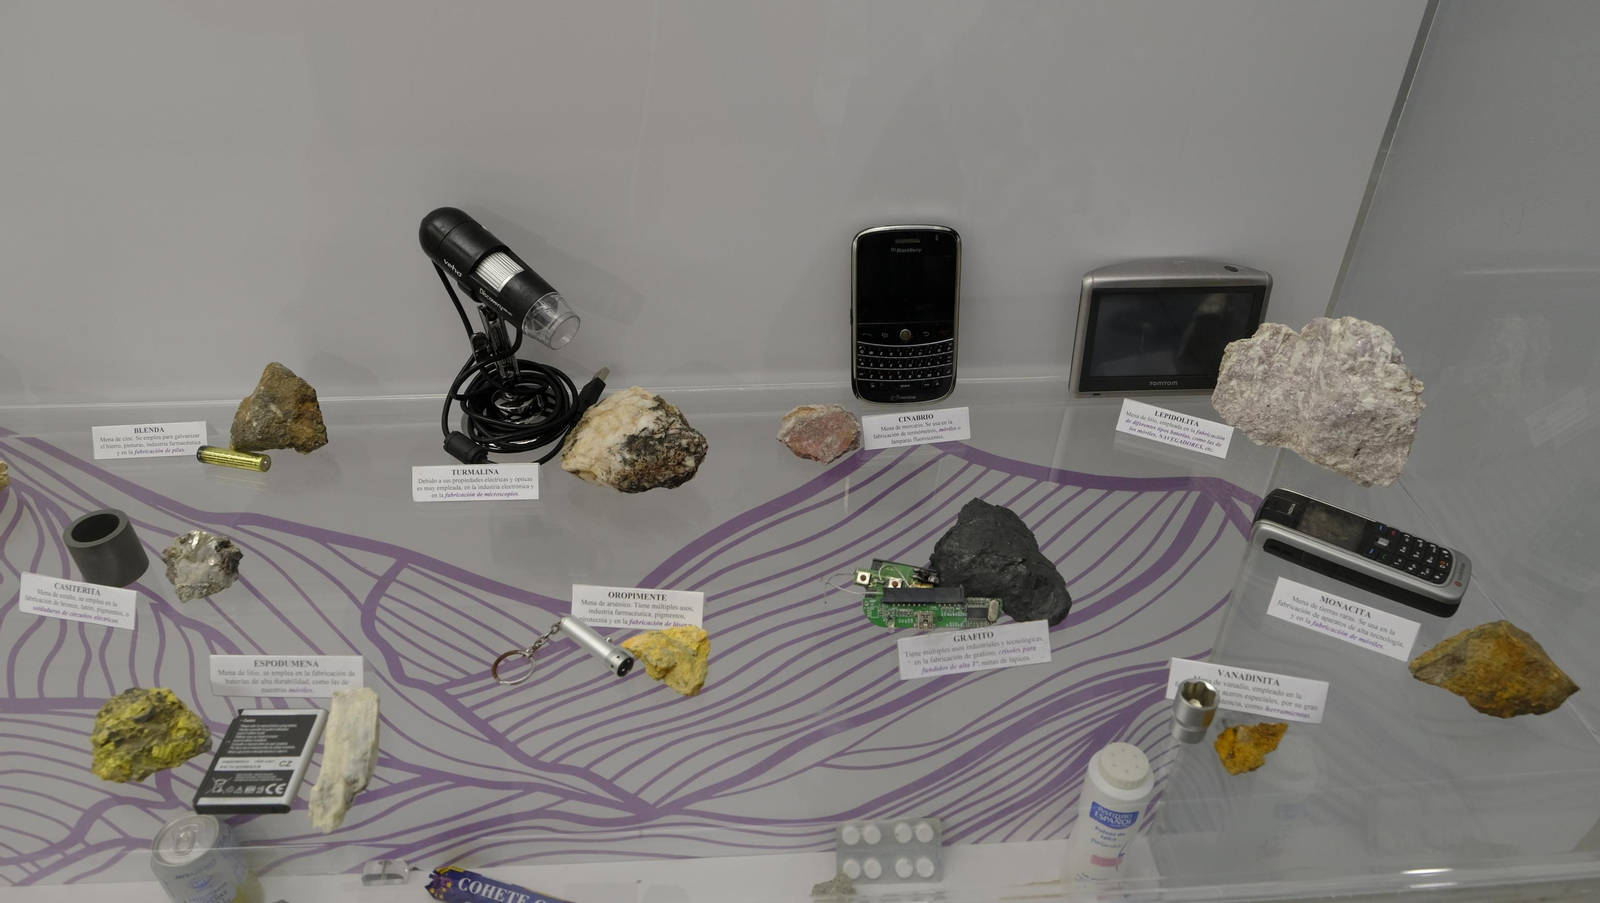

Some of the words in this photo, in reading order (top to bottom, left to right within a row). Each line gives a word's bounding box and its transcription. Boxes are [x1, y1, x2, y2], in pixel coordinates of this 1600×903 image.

[898, 414, 934, 422] CINABRIO
[1155, 410, 1199, 427] LEPIDOLITA
[54, 583, 100, 596] CASITERITA
[608, 592, 667, 601] OROPIMENTE
[1292, 595, 1309, 606] Mena
[1319, 605, 1338, 616] tierras
[1320, 595, 1371, 618] MONACITA
[1321, 616, 1346, 628] aparatos
[1357, 627, 1368, 636] alta
[953, 631, 994, 642] GRAFITO
[1218, 669, 1280, 686] VANADINITA
[1252, 687, 1284, 696] empleado
[1094, 811, 1132, 825] ESPAÑOL
[1098, 806, 1132, 819] INSTITUTO
